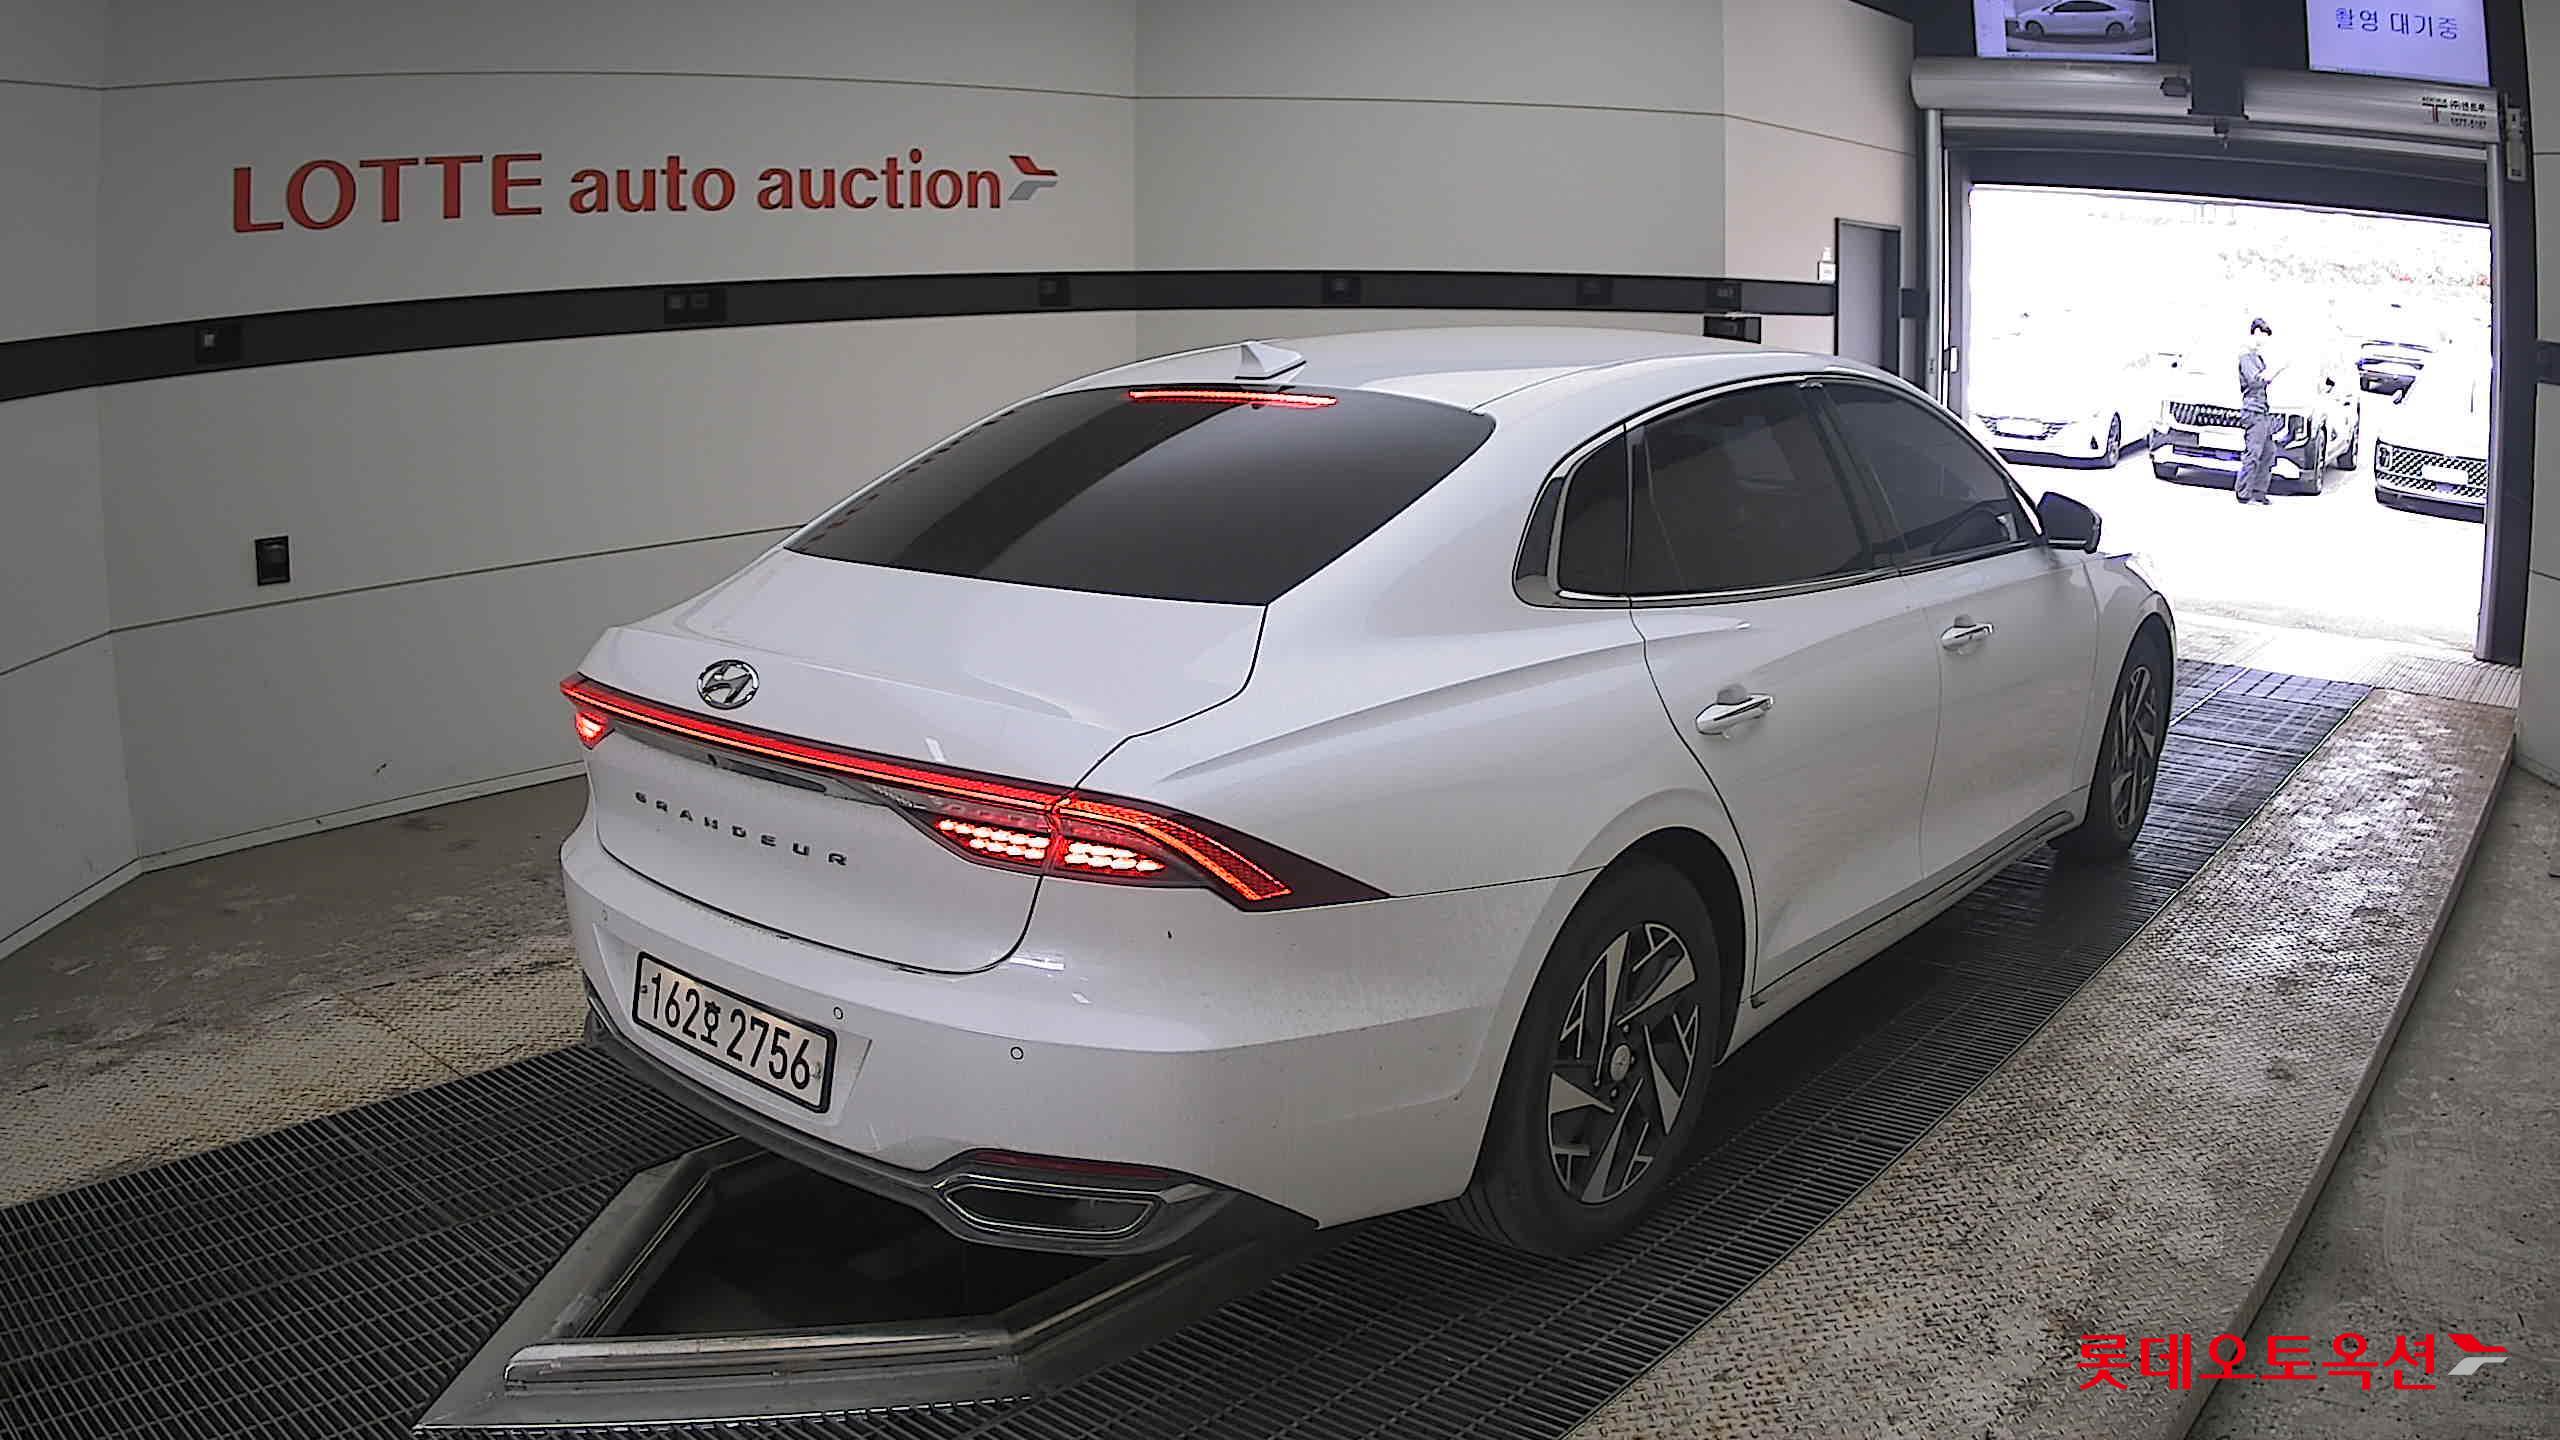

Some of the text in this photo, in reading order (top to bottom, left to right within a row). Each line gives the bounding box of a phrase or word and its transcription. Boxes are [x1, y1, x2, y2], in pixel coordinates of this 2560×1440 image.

[2335, 7, 2458, 41] 촬영 대기중
[232, 147, 1003, 234] LOTTE auto auction
[634, 790, 849, 867] GRANDEUR
